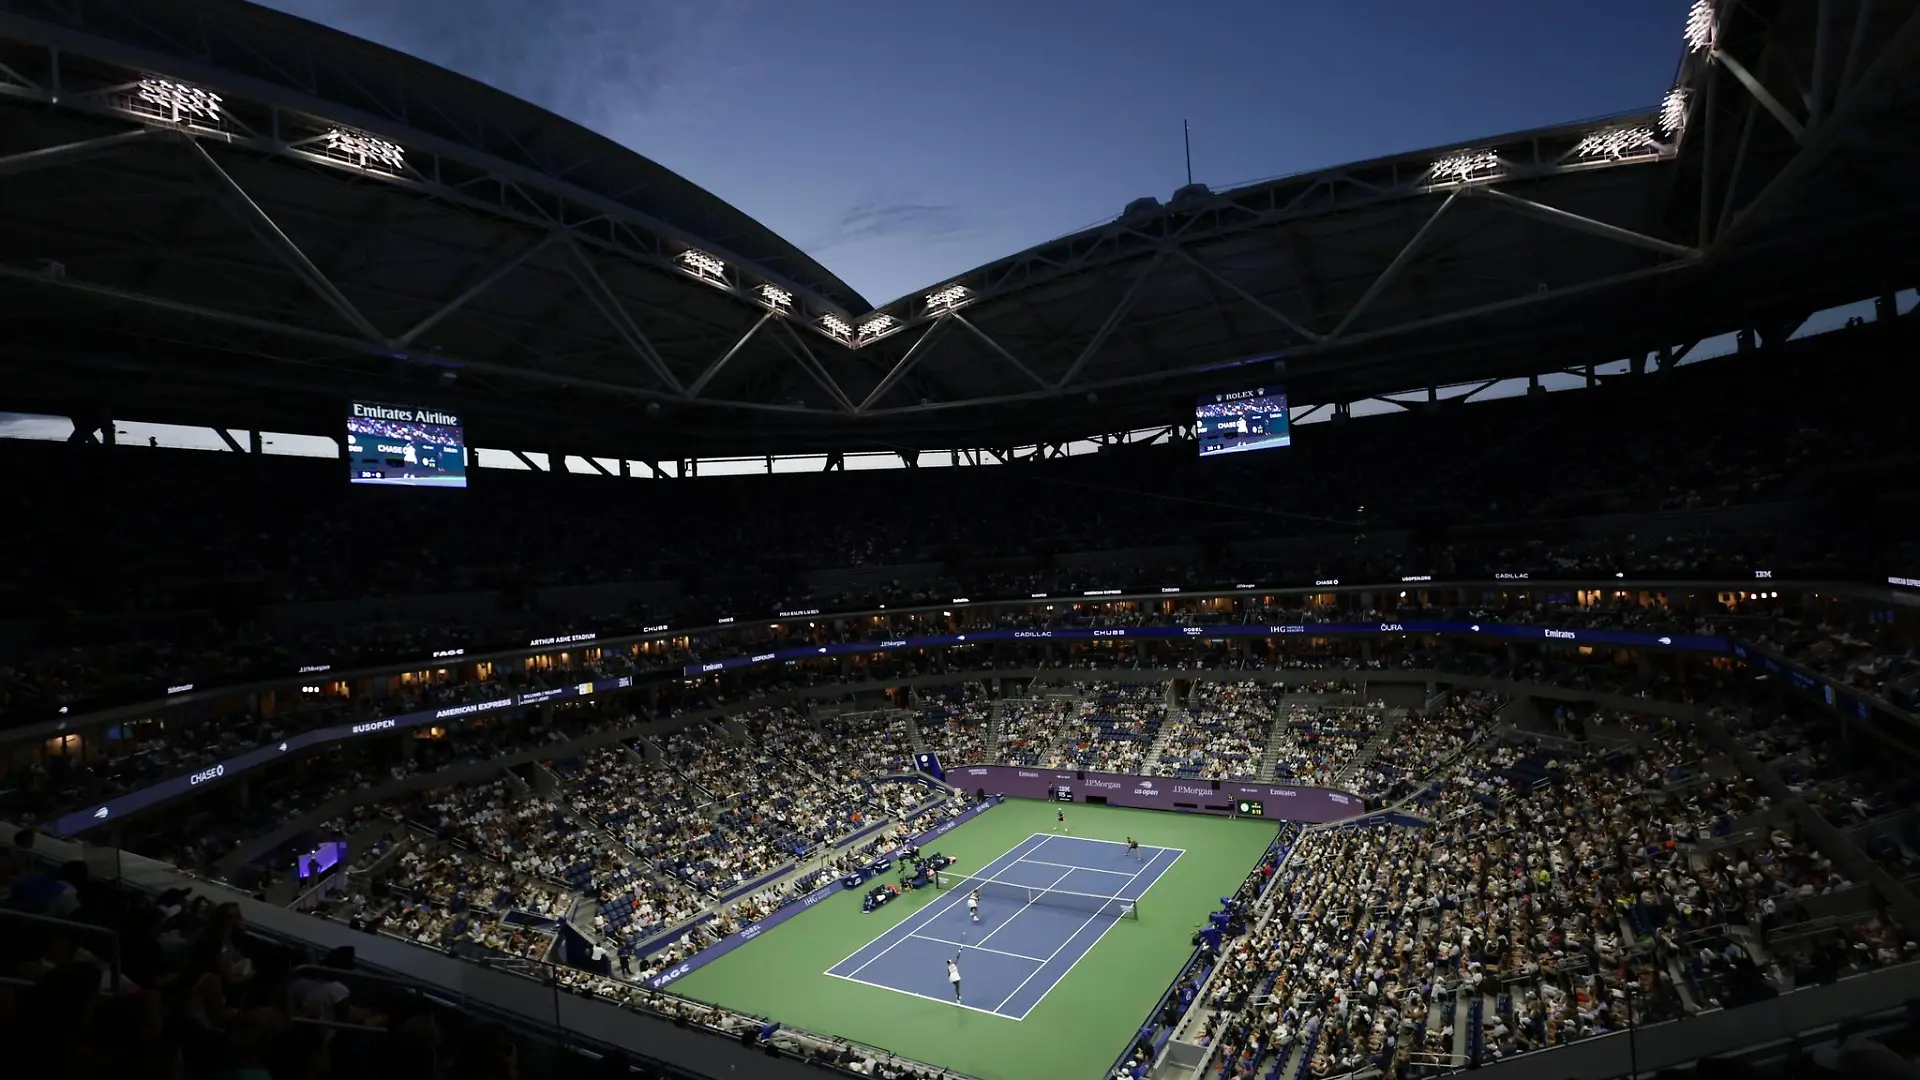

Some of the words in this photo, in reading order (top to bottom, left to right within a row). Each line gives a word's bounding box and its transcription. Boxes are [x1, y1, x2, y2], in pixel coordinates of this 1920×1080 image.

[1225, 390, 1255, 401] ROLEX
[351, 403, 413, 422] Emirates
[415, 410, 457, 426] Airline
[1755, 570, 1772, 578] IBM
[643, 624, 668, 633] CHUBB
[1270, 625, 1286, 633] IHG
[1544, 628, 1576, 639] Emirates
[530, 637, 555, 646] ARTHUR
[556, 635, 572, 643] ASHE
[572, 632, 596, 642] STADIUM
[435, 704, 478, 718] AMERICAN
[477, 698, 512, 711] EXPRESS
[352, 719, 395, 734] #USOPEN
[190, 767, 217, 785] CHASE
[1084, 779, 1121, 790] J.P.Morgan
[1144, 789, 1159, 797] open
[1172, 785, 1213, 797] J.P.Morgan
[1269, 788, 1297, 797] Emirates
[803, 895, 819, 907] IHG
[741, 924, 762, 938] DOBEL
[653, 964, 690, 988] FAGE
